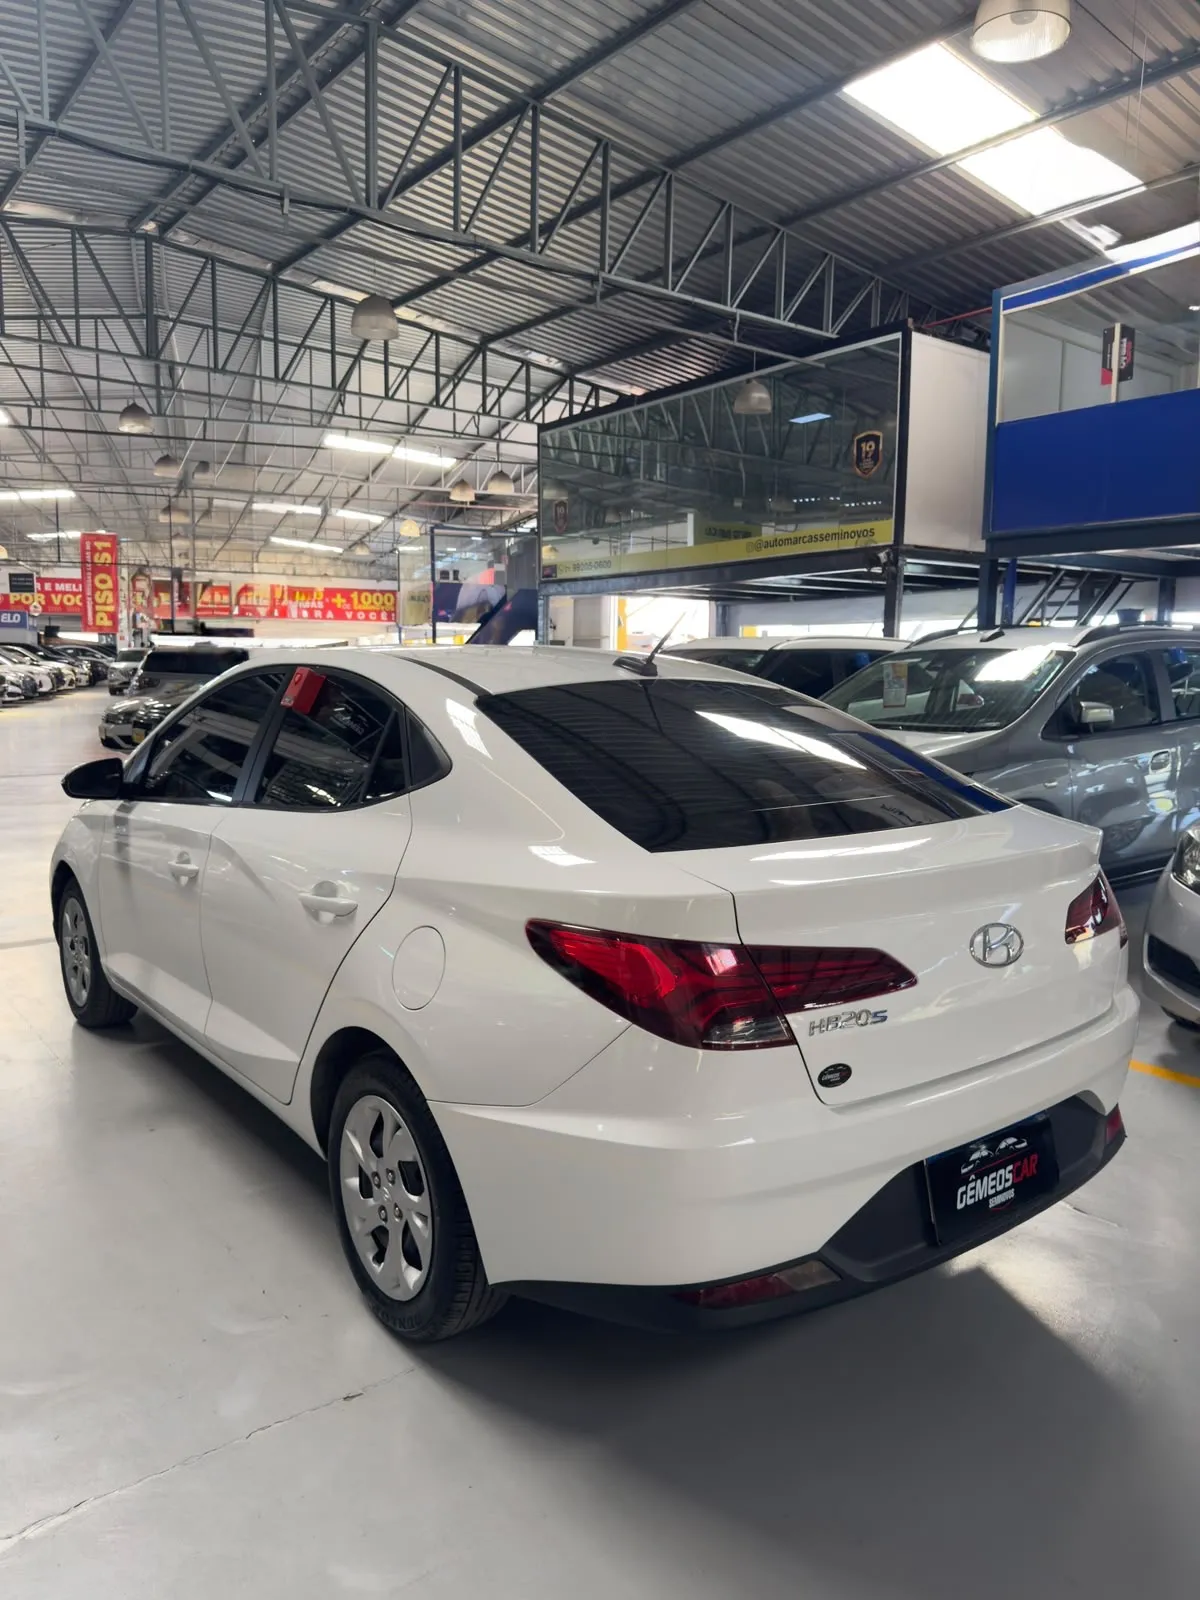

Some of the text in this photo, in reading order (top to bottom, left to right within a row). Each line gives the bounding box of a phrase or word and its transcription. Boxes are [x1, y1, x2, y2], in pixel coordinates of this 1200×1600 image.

[9, 593, 46, 605] POR
[94, 541, 115, 627] PISO S1
